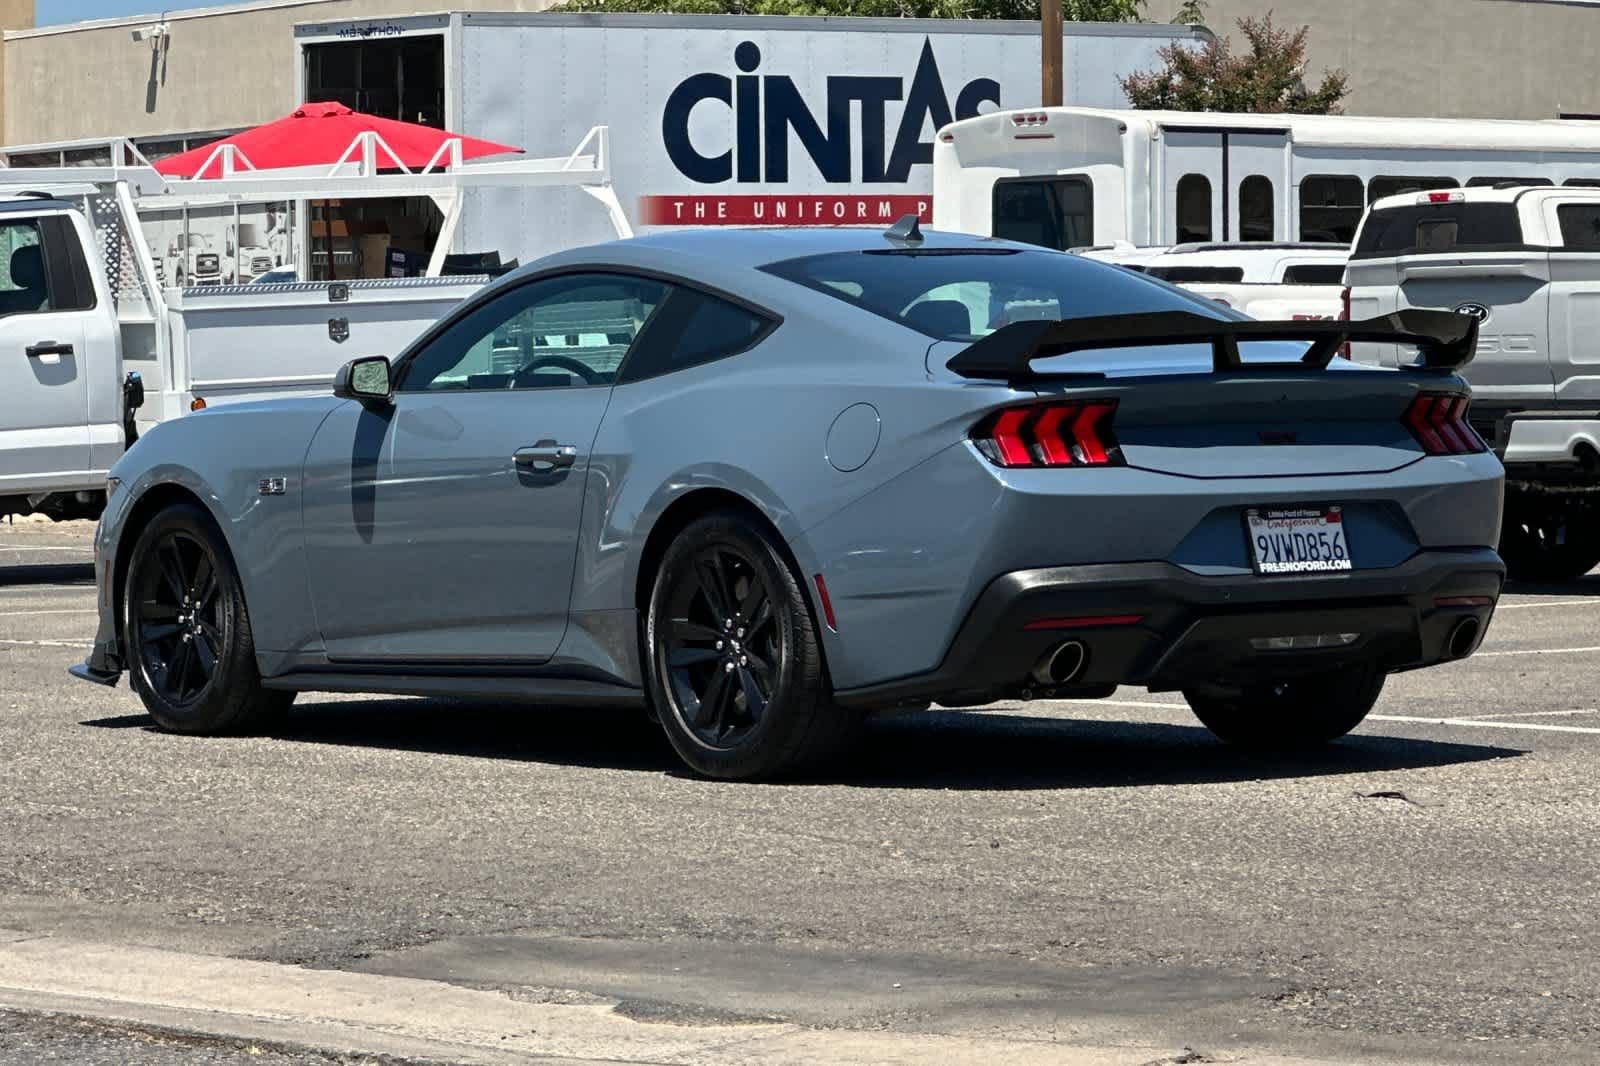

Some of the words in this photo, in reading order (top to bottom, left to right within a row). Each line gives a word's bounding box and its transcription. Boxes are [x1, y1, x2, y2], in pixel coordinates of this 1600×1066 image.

[674, 201, 727, 218] THE
[754, 201, 892, 218] UNIFORM
[1257, 532, 1344, 562] 9VWD856
[1259, 559, 1352, 573] FRESNOFORD.COM
